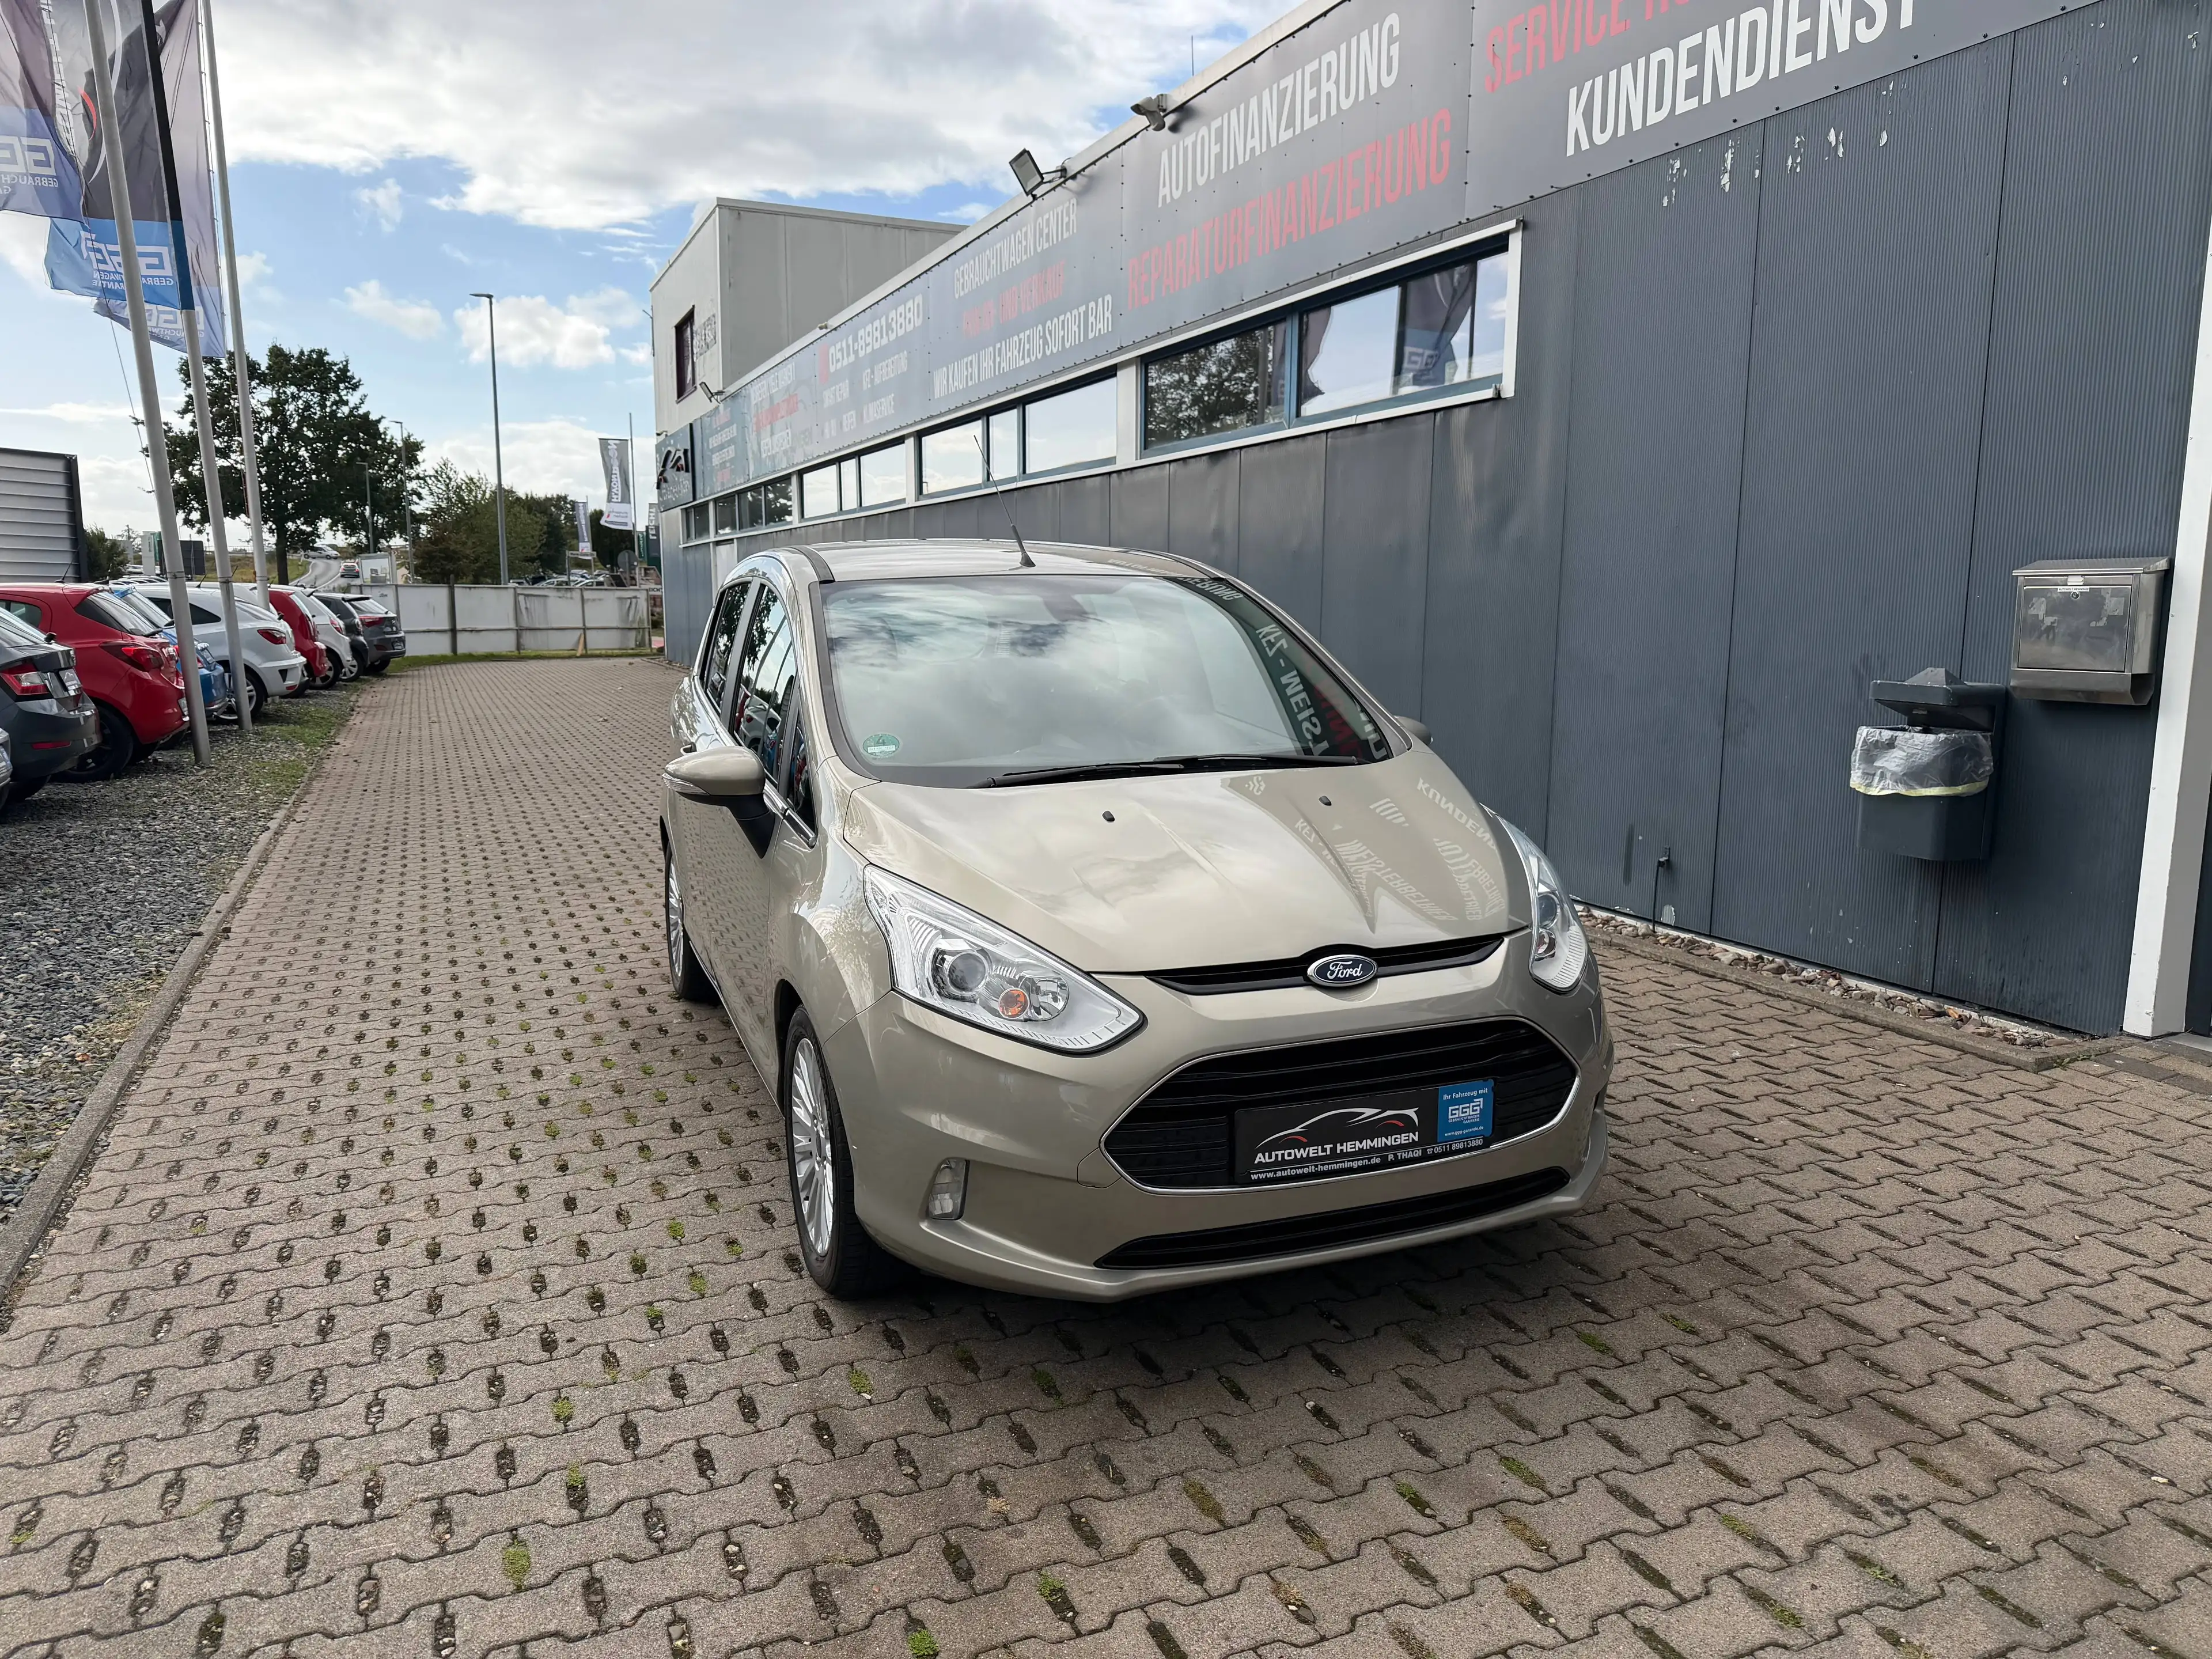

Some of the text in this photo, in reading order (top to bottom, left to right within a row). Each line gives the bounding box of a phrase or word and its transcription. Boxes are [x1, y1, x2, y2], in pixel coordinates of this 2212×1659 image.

[1485, 0, 1630, 94] SERVICE
[1157, 12, 1400, 208] AUTOFINANZIERUNG
[1128, 108, 1452, 310] REPARATURFINANZIERUNG
[954, 198, 1077, 299] GEBRAUCHTWAGEN CENTER
[828, 293, 923, 373] 0511-89813880
[933, 294, 1112, 399] WIR KAUFEN IHR FAHRZEUG SOFORT BAR
[876, 735, 887, 745] 4
[1327, 961, 1363, 979] Ford
[1448, 1100, 1482, 1119] GGG
[1452, 1090, 1478, 1099] Fahrzeug
[1254, 1131, 1419, 1164] AUTOWELT HEMMINGEN
[1445, 1126, 1484, 1137] www.ggg-garantie.de
[1251, 1157, 1381, 1180] www.autowelt-hemmingen.de
[1396, 1149, 1422, 1160] THAQI
[1434, 1145, 1450, 1154] 0511
[1452, 1138, 1483, 1151] 89813880
